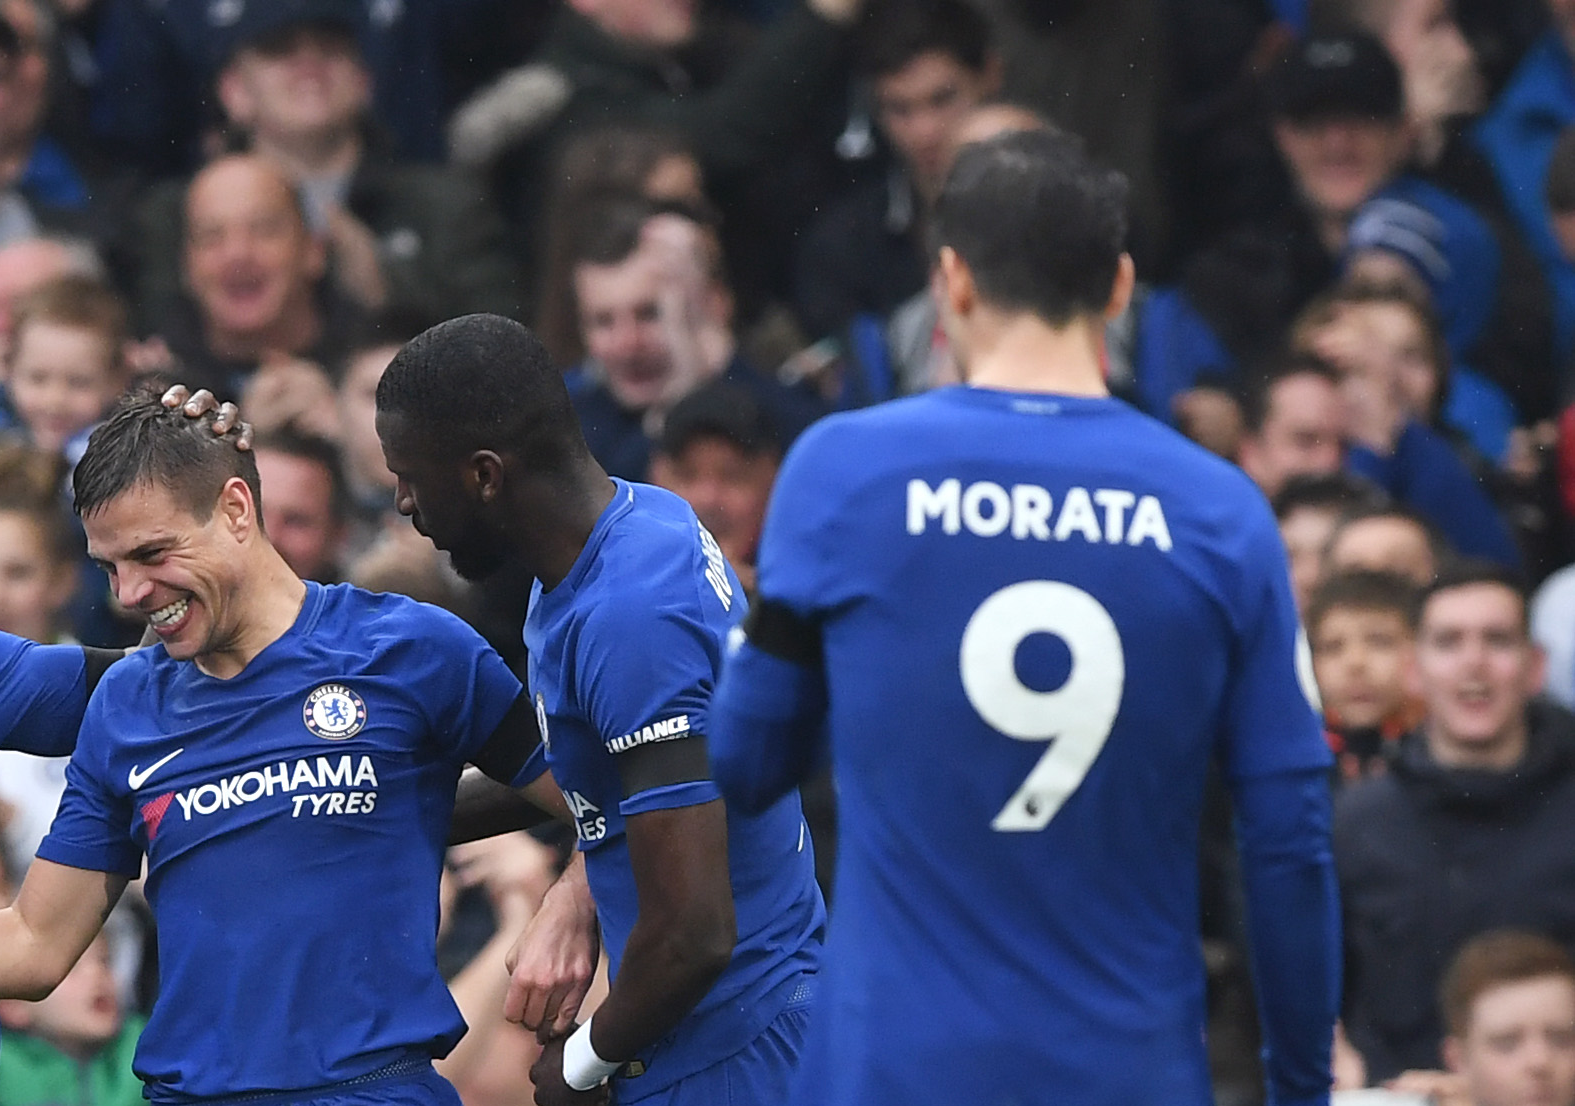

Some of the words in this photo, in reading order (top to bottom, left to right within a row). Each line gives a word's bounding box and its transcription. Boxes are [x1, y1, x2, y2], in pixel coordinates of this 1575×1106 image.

[906, 477, 1174, 553] MORATA
[310, 685, 350, 702] CHELSEA
[959, 579, 1124, 832] 9
[175, 755, 379, 821] YOKOHAMA
[291, 792, 377, 818] TYRES
